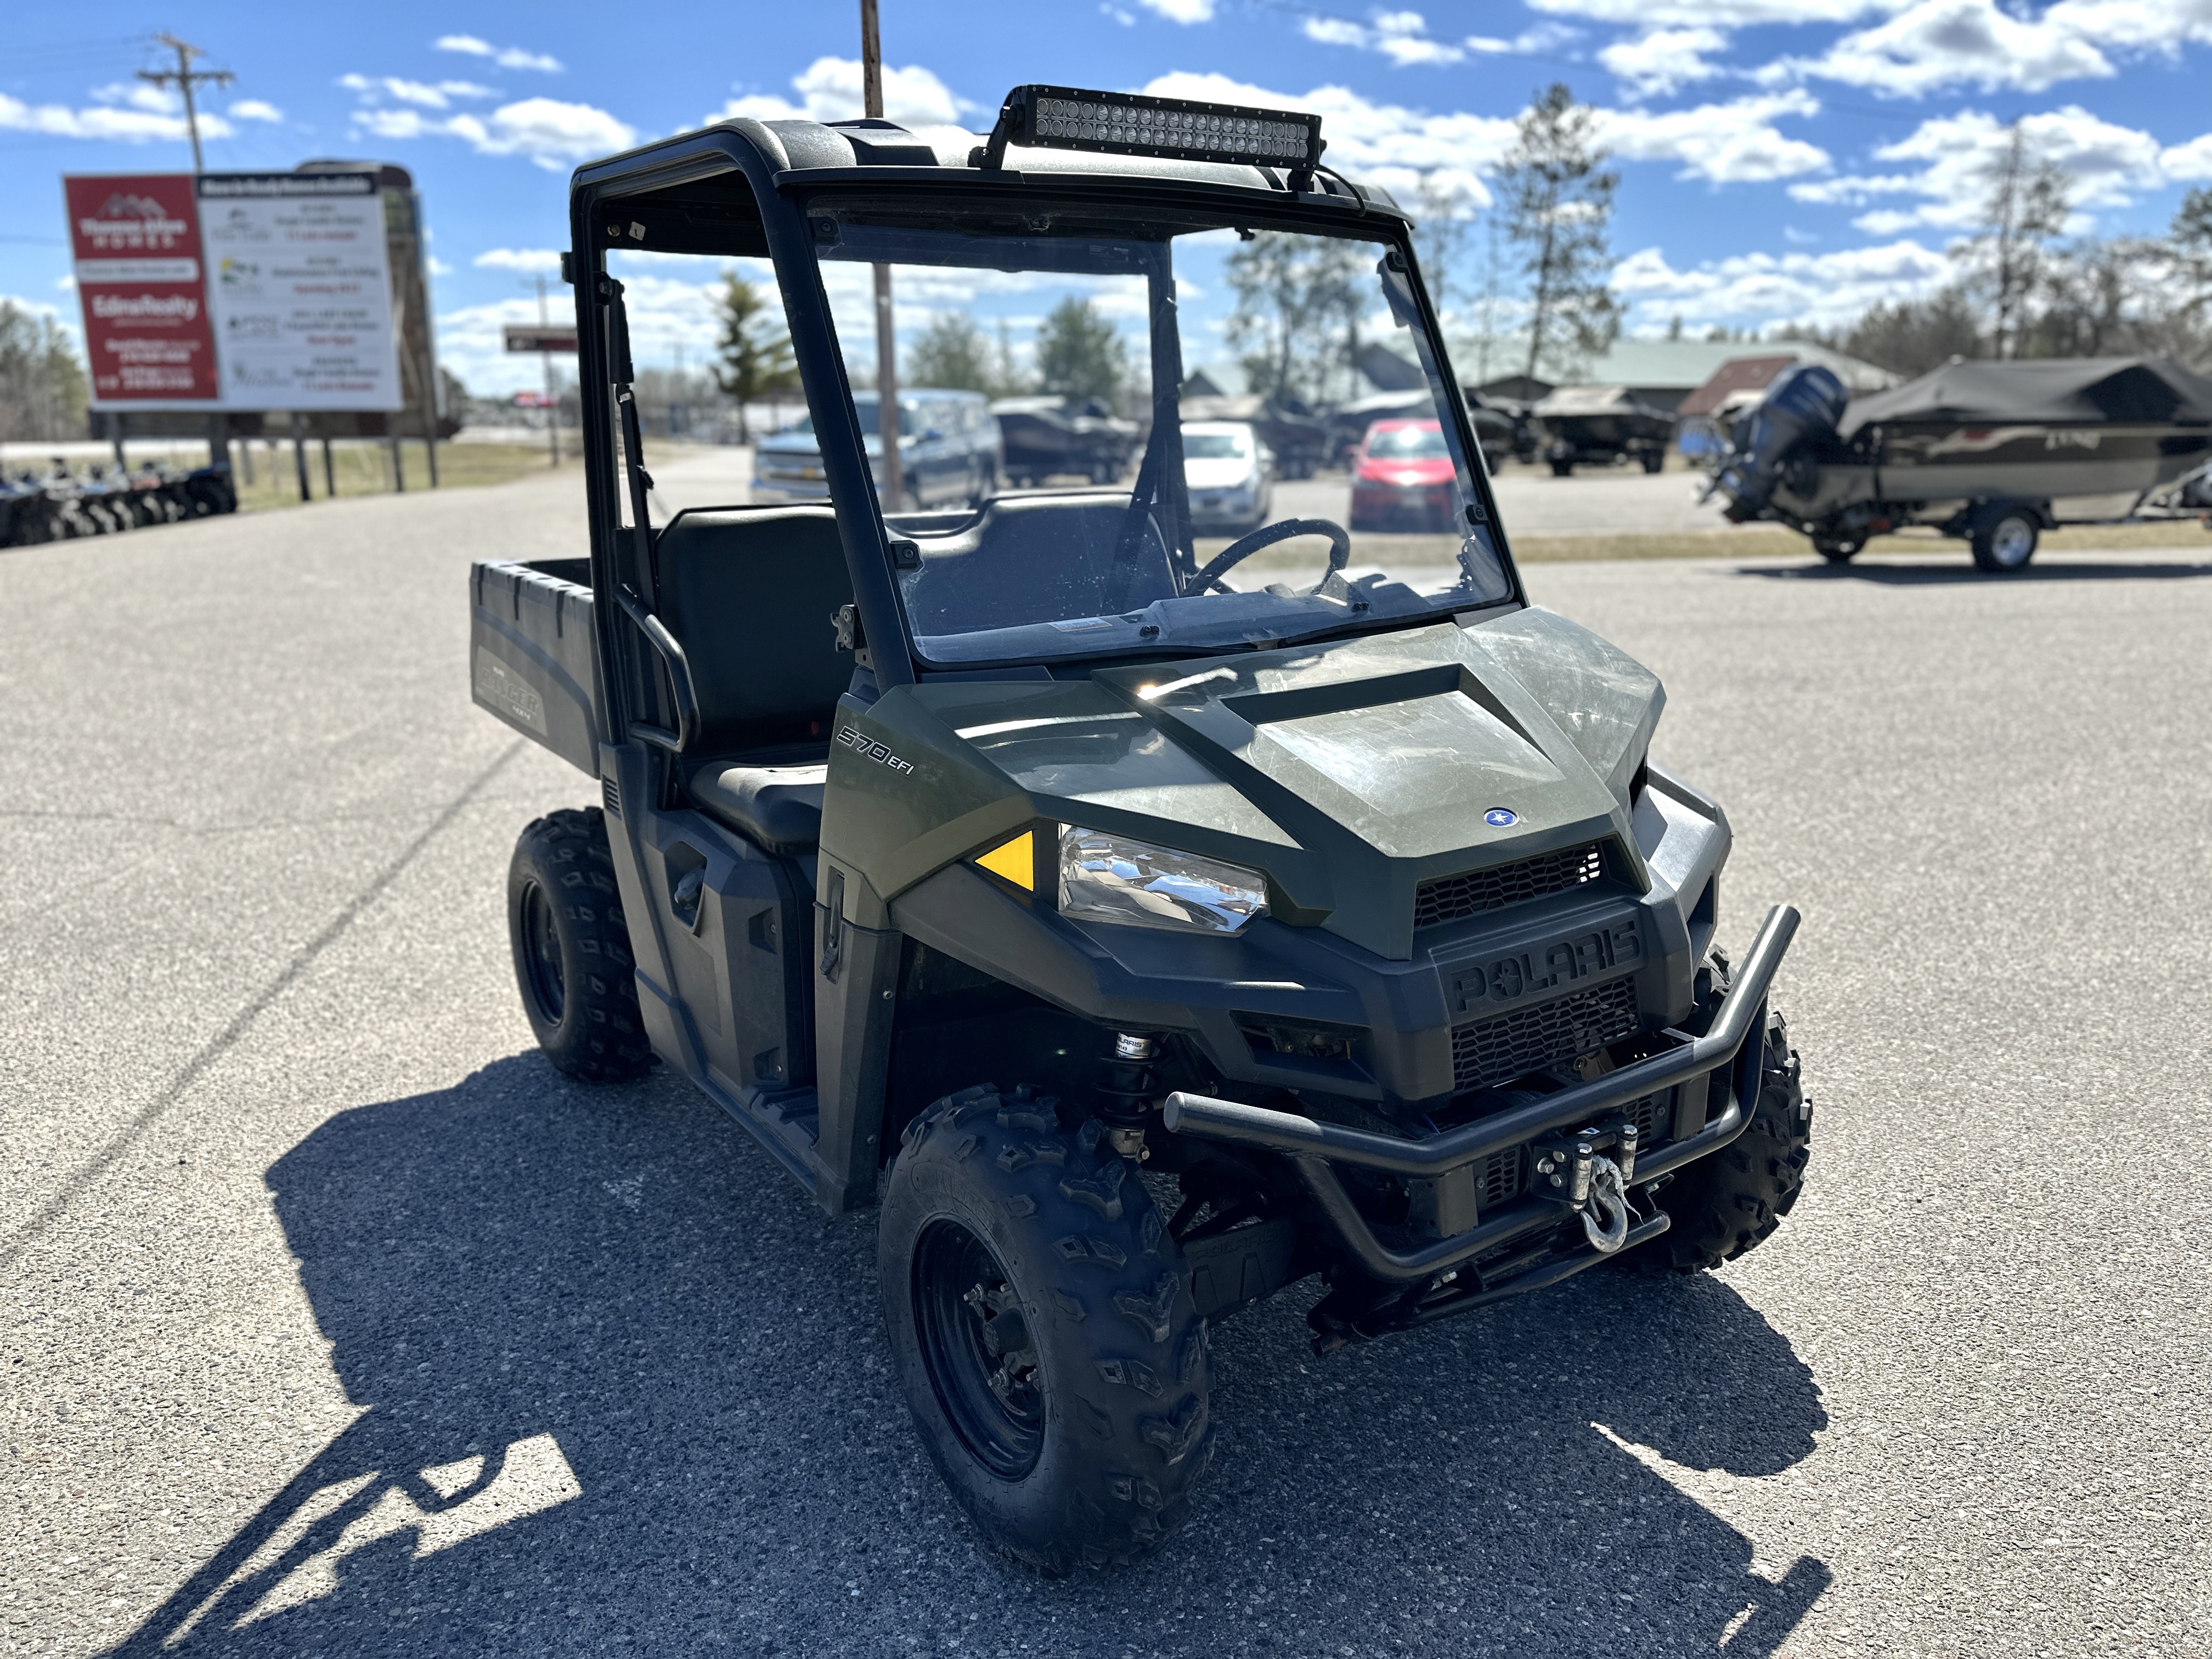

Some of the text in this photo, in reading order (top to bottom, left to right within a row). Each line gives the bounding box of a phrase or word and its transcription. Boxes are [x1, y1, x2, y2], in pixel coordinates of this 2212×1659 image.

[80, 218, 187, 235] Thomas Allen
[93, 234, 174, 249] HOMES
[92, 295, 198, 320] EdinaRealty
[837, 725, 915, 775] 570 EFI
[1449, 919, 1641, 1014] POLARIS
